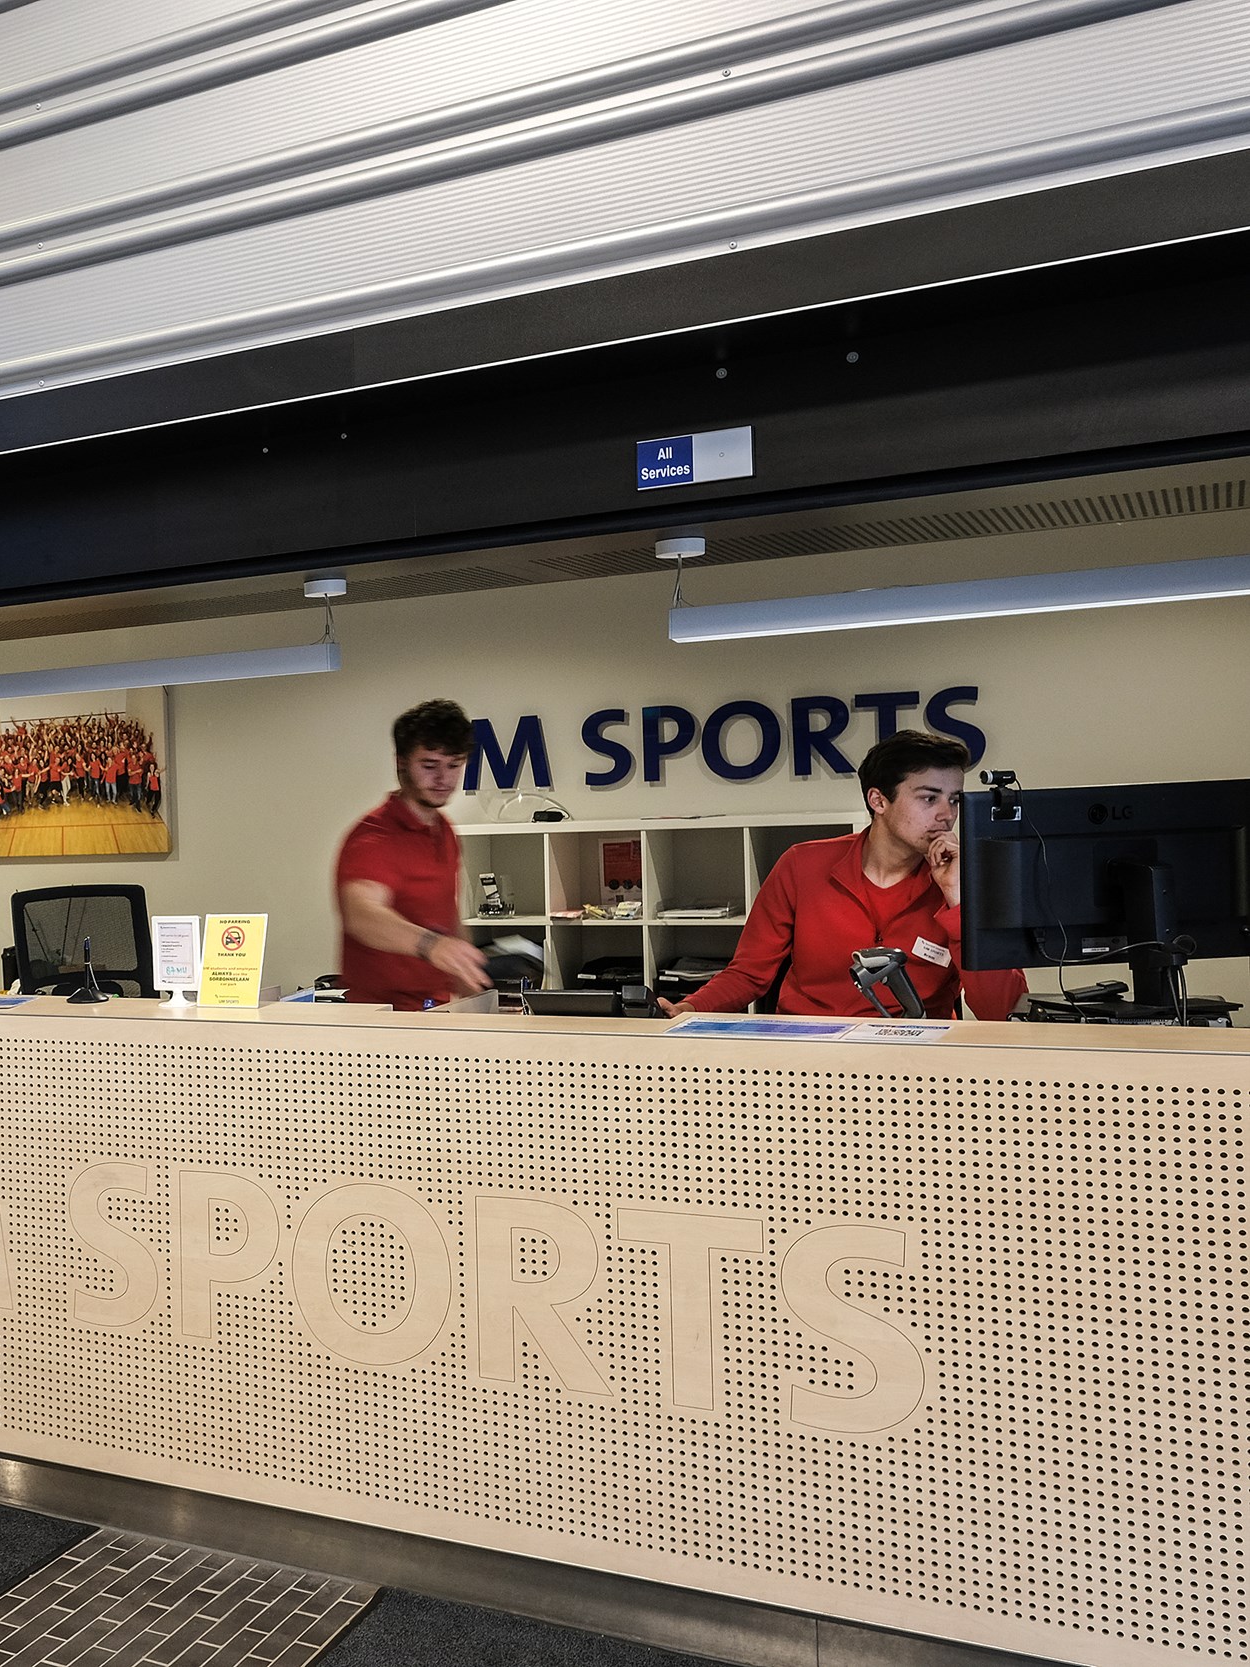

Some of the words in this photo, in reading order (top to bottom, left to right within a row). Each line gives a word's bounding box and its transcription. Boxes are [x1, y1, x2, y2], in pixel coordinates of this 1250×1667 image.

[657, 446, 673, 461] All
[641, 464, 691, 481] Services
[462, 714, 551, 791] M
[580, 685, 987, 788] SPORTS
[1111, 804, 1134, 822] LG
[69, 1161, 928, 1435] SPORTS
